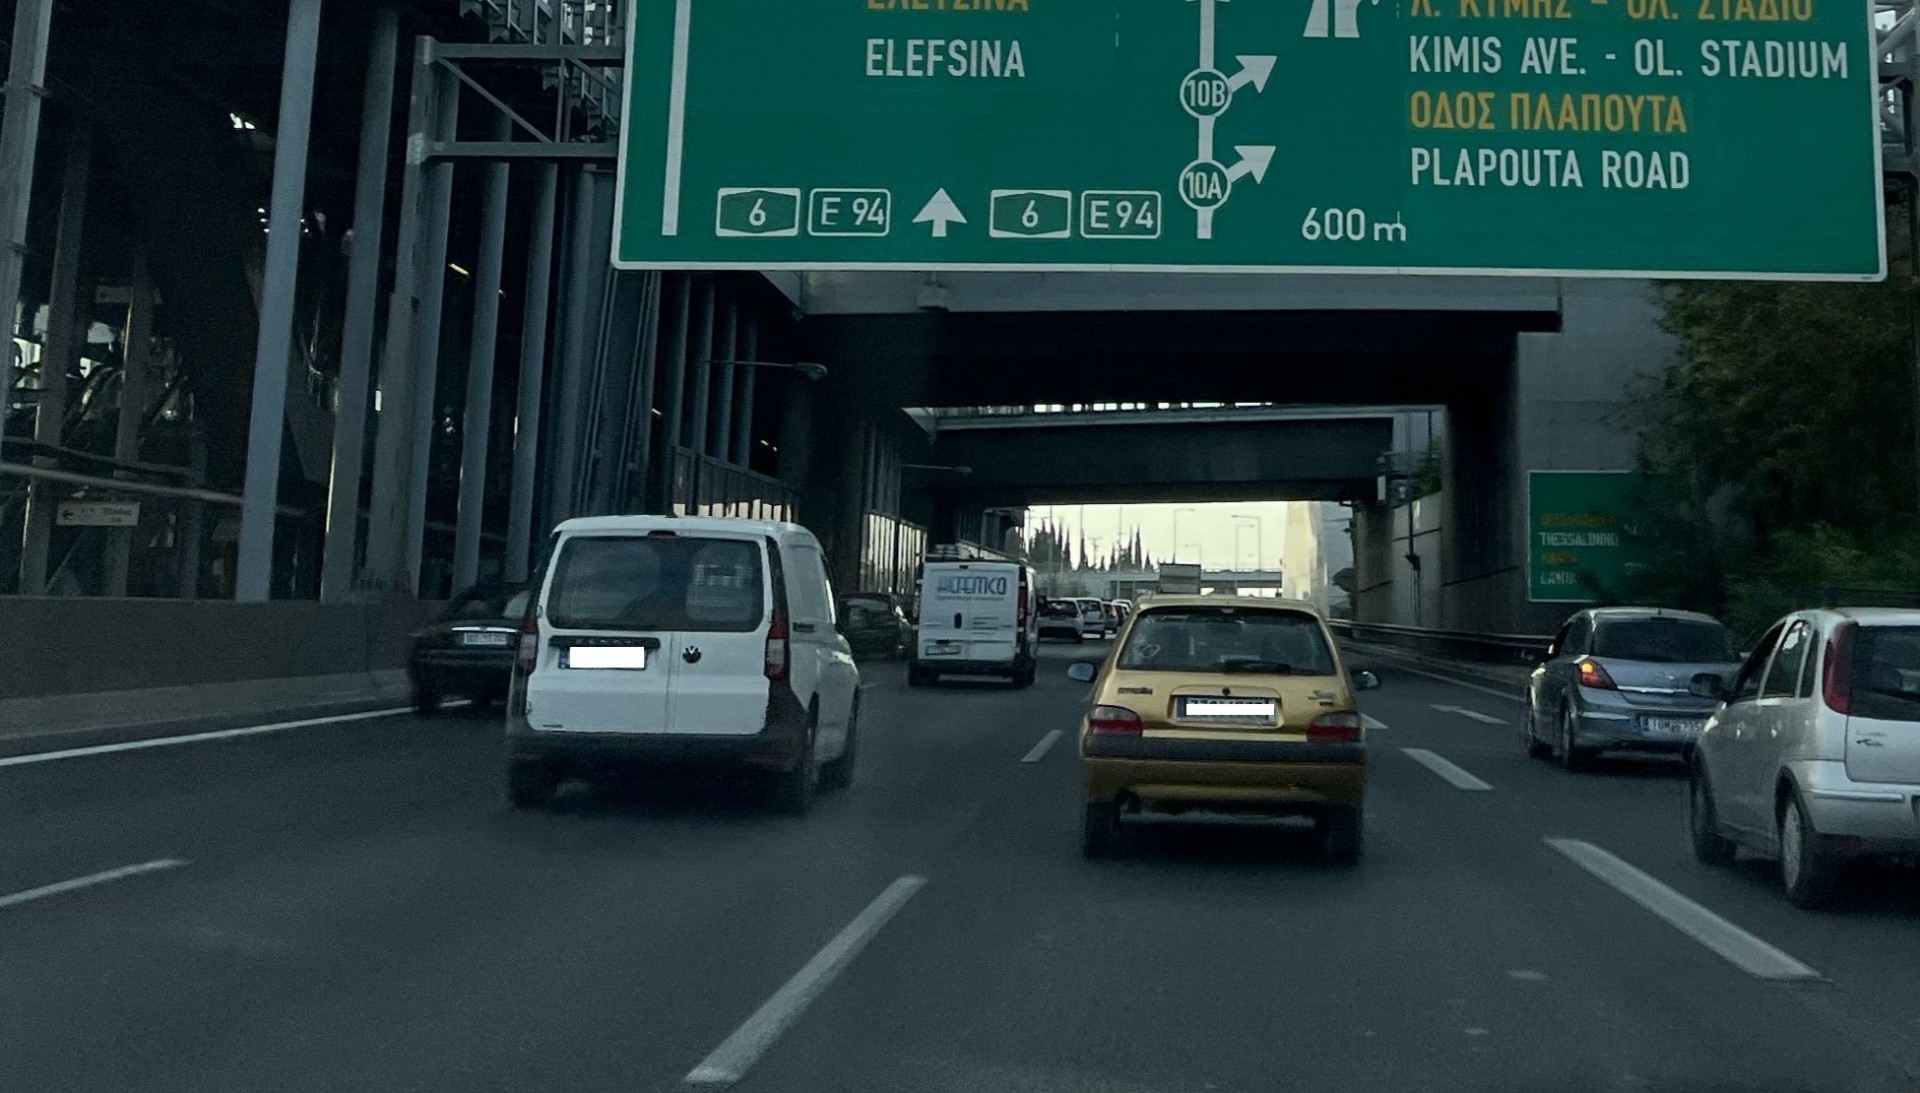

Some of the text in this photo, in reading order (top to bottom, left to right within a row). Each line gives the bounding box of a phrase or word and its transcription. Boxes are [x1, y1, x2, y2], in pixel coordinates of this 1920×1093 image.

[866, 38, 1025, 78] ELEFSINA
[1410, 35, 1502, 74] KIMIS
[1520, 37, 1586, 75] AVE.
[1634, 38, 1683, 76] OL.
[1701, 39, 1848, 79] STADIUM
[1187, 80, 1225, 107] 10B
[1411, 91, 1688, 132] ΟΔΟΣ ΠΛΑΠΟΥΤΑ
[1186, 171, 1222, 199] 10A
[1411, 147, 1690, 189] PLAPOUTA ROAD
[749, 198, 766, 227] 6
[1022, 199, 1039, 228] 6
[1301, 207, 1407, 241] 600 m
